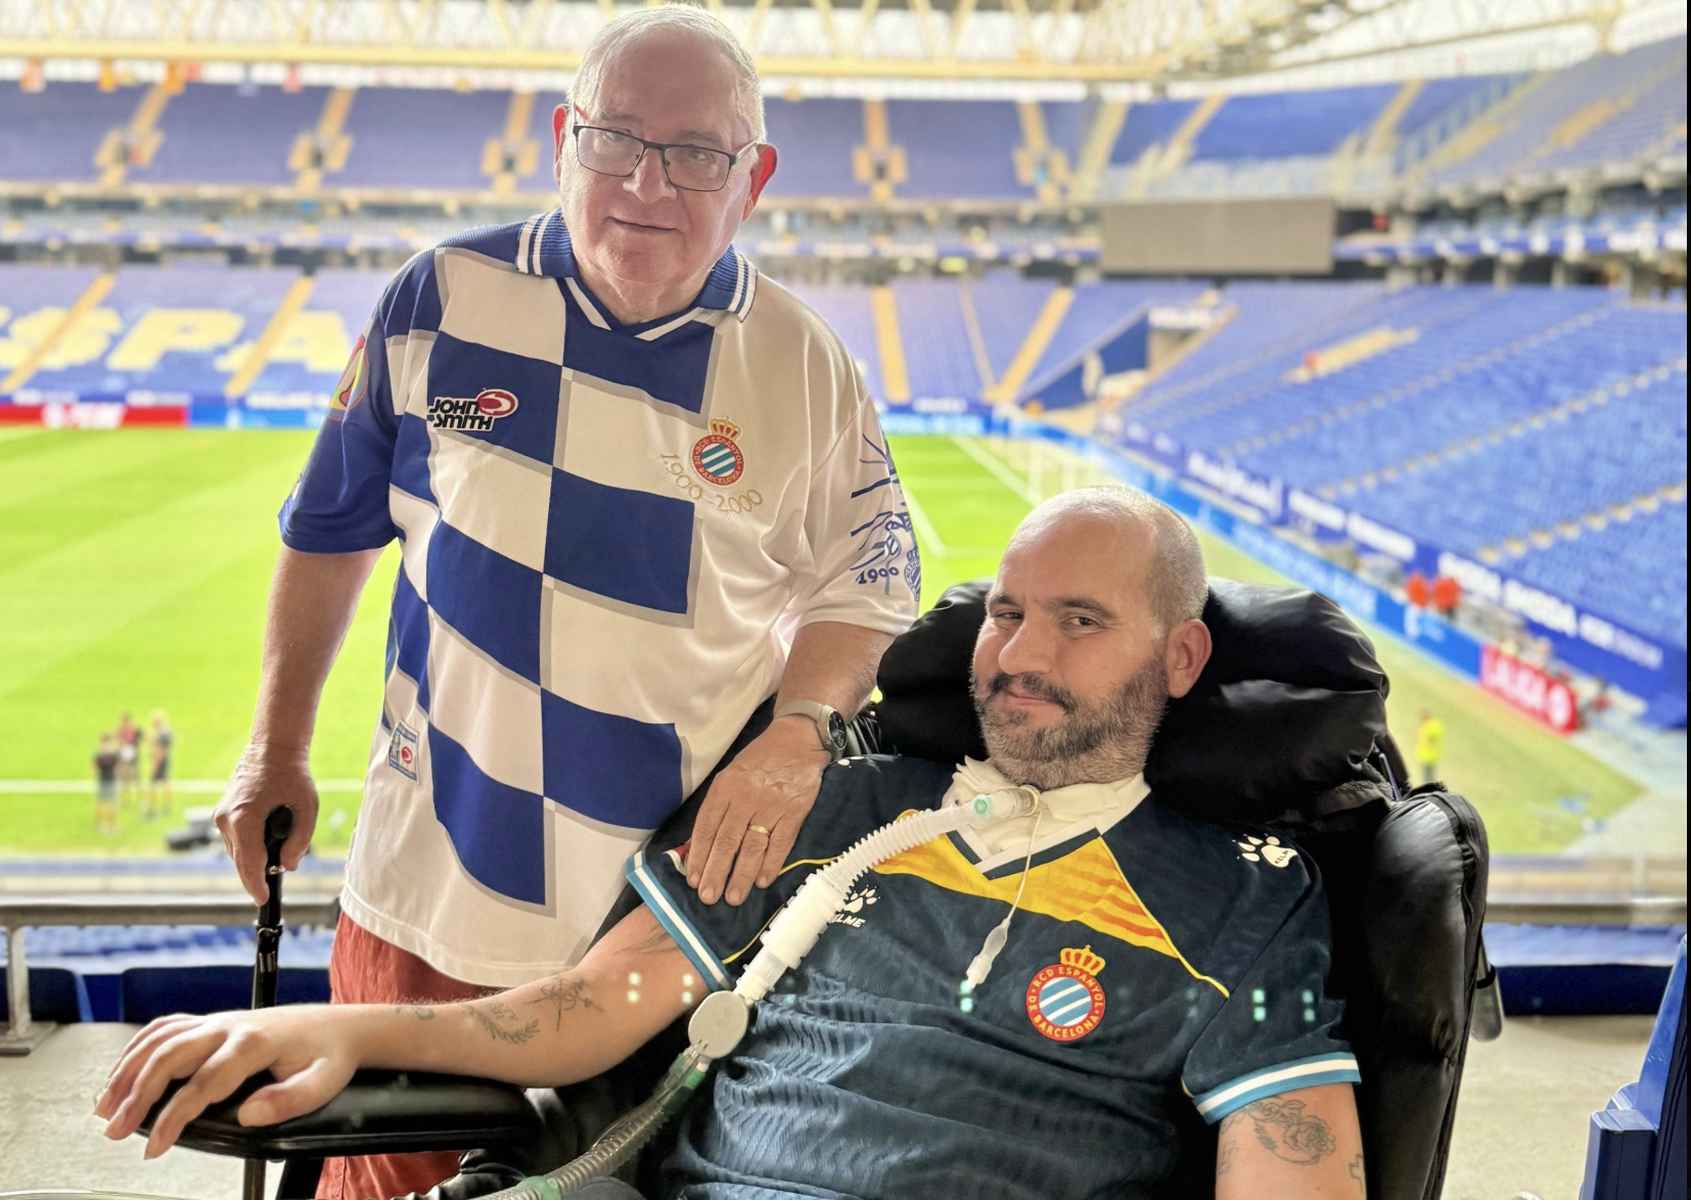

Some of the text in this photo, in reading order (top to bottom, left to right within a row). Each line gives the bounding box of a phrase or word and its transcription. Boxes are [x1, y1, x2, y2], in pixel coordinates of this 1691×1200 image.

[429, 399, 480, 414] JOHN
[433, 414, 492, 430] SMITH
[855, 566, 899, 585] 1900
[1057, 966, 1104, 1007] ESPANYOL
[1033, 1013, 1101, 1038] BARCELONA
